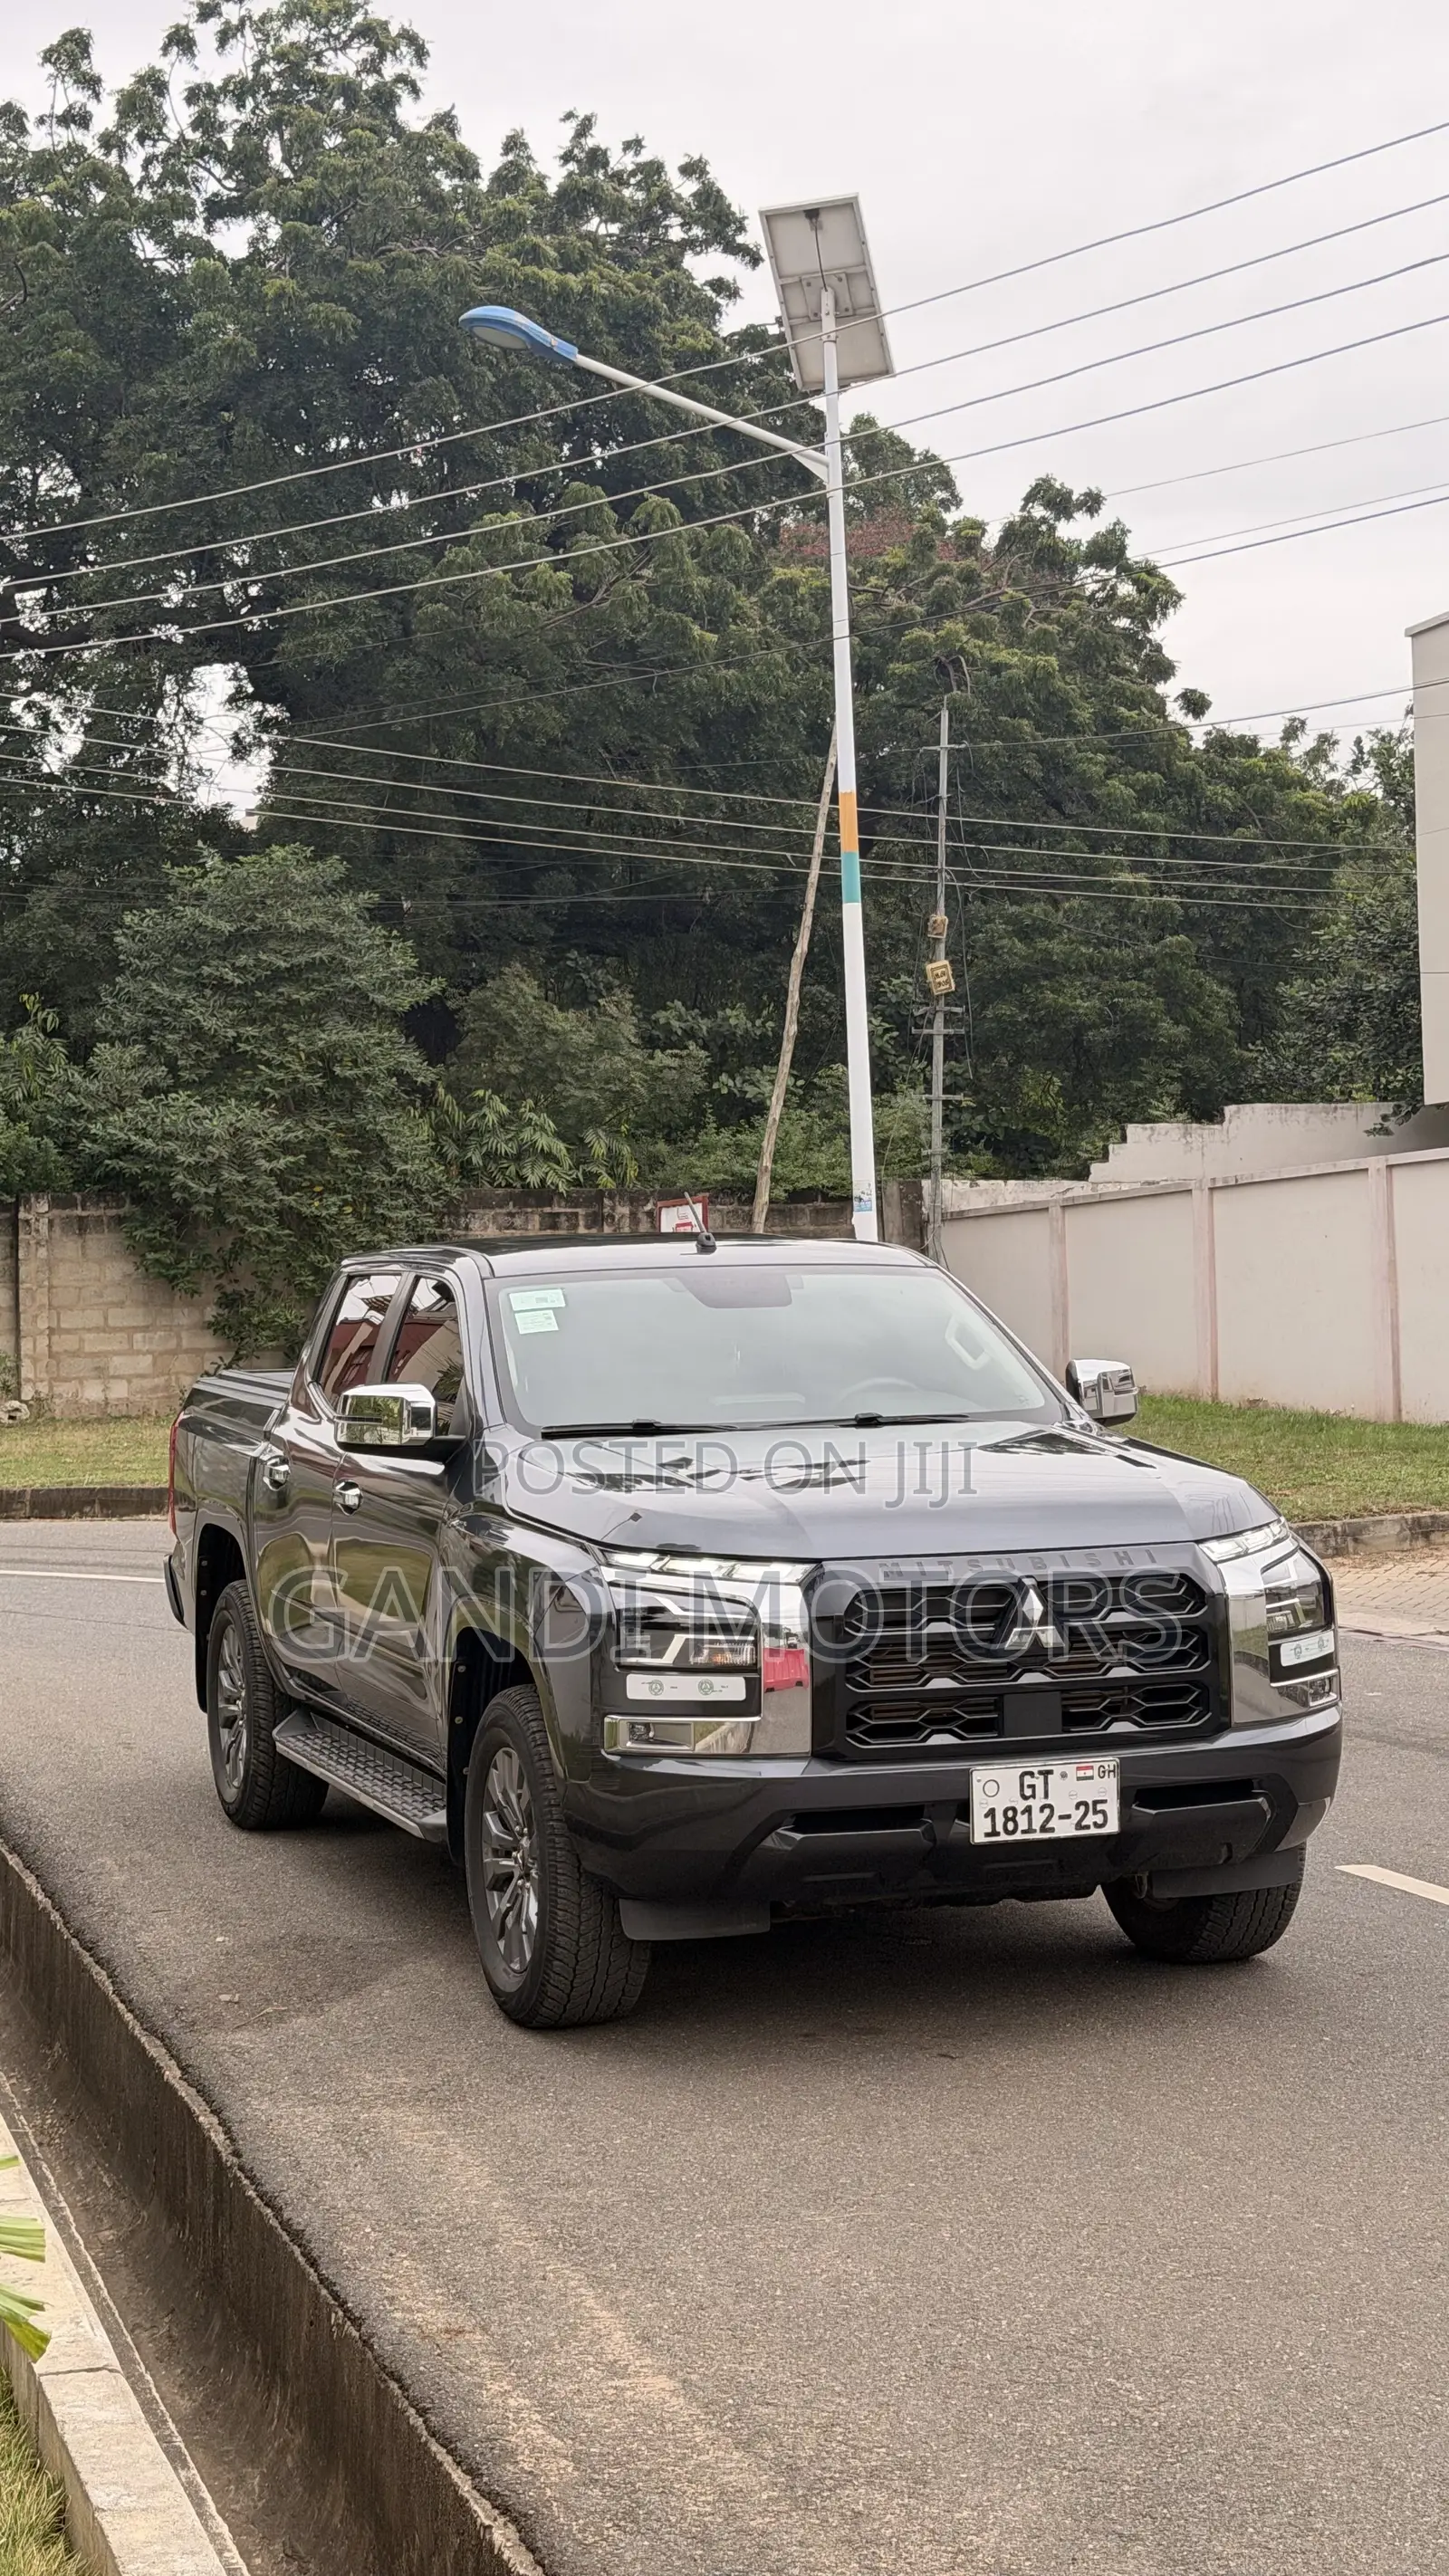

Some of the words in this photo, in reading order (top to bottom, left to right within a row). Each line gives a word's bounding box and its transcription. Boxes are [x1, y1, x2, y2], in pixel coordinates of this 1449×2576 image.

[878, 1548, 1158, 1577] MITSUBISHI
[1019, 1768, 1054, 1801] GT
[1098, 1764, 1117, 1779] GH
[984, 1798, 1108, 1837] 1812-25
